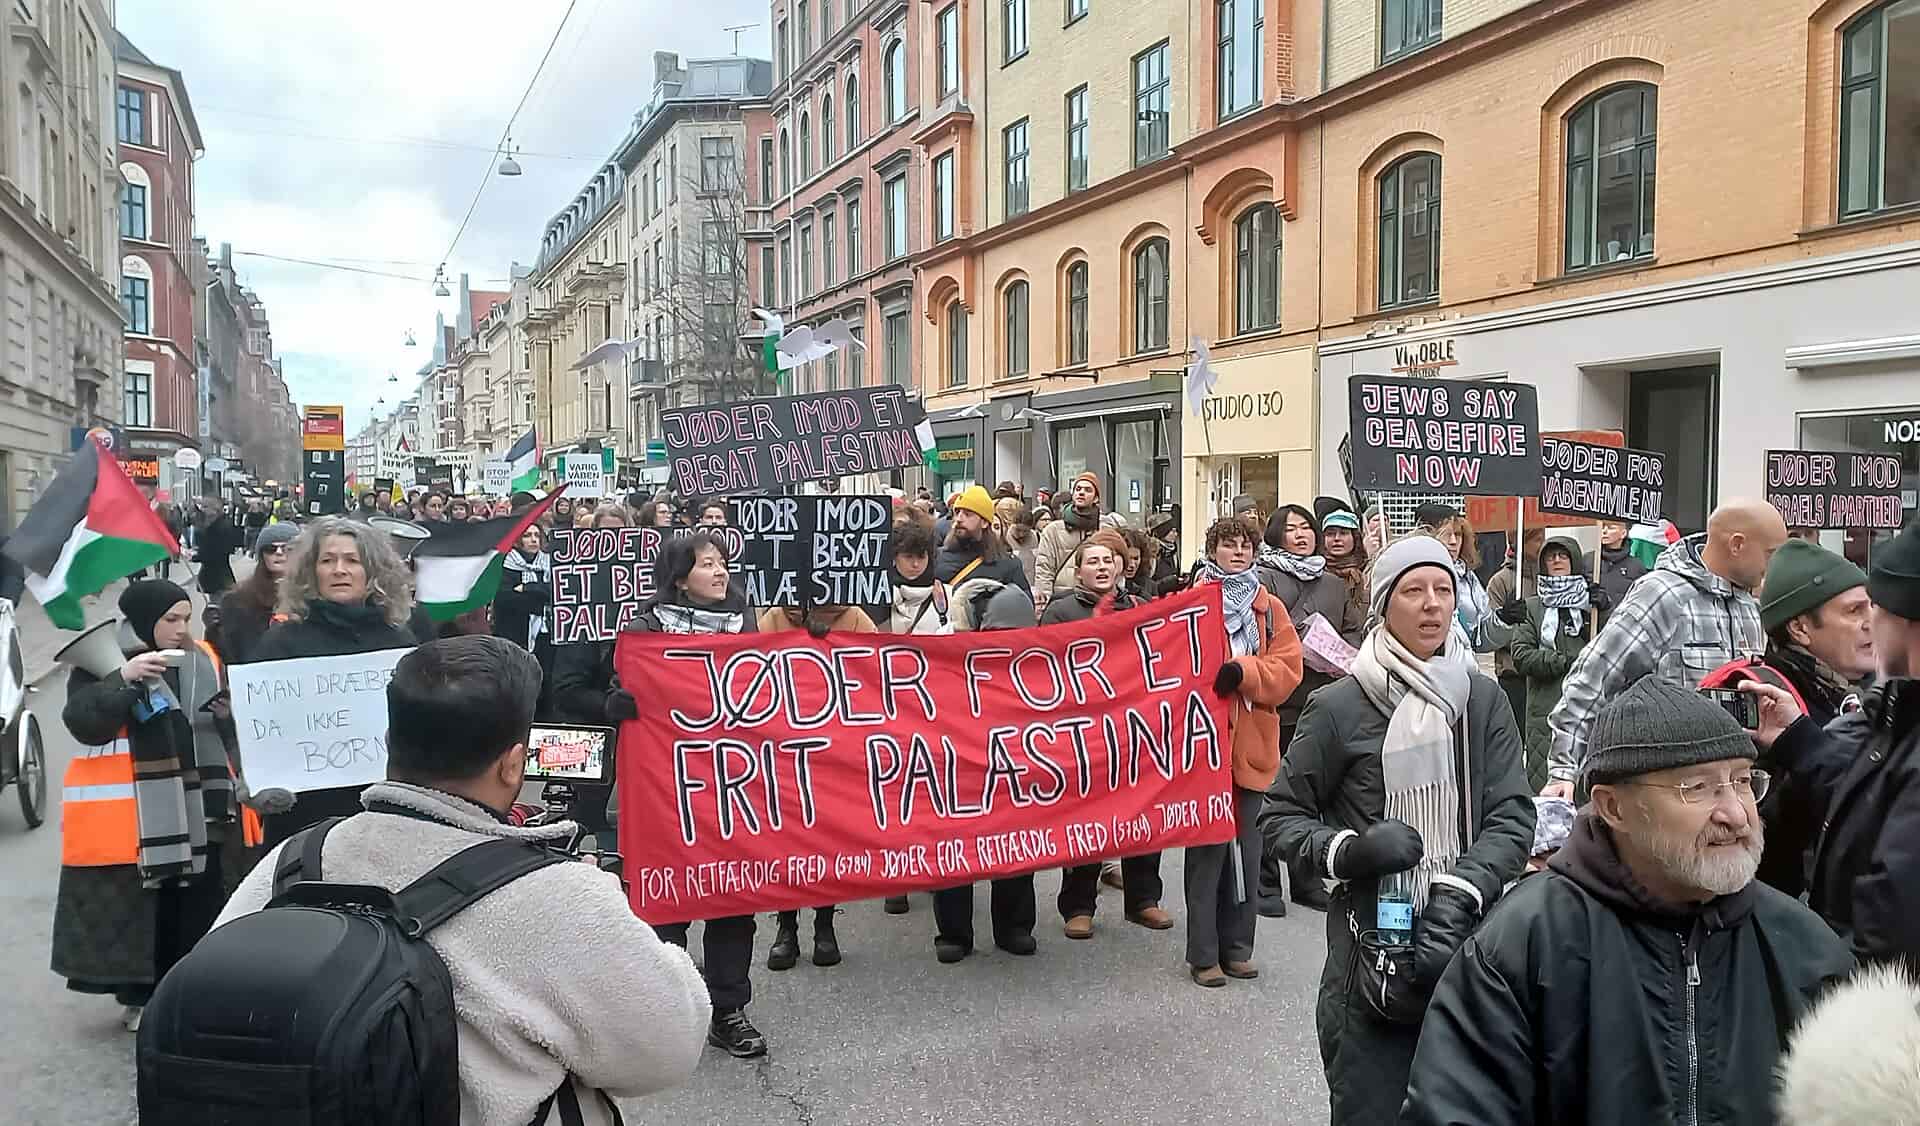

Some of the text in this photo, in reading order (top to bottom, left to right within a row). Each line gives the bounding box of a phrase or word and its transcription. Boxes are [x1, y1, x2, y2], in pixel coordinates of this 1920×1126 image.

[1395, 339, 1455, 370] VINOBLE
[663, 391, 904, 448] JØDER IMOD ET
[1205, 390, 1283, 421] STUDIO 130
[1362, 384, 1517, 419] JEWS SAY
[1366, 418, 1526, 457] CEASEFIRE
[676, 428, 923, 497] BESAT PALÆSTINA
[1396, 453, 1481, 488] NOW
[1542, 439, 1663, 486] JØDER FOR
[1768, 454, 1900, 489] JØDER IMOD
[729, 497, 887, 533] JØDER IMOD
[1829, 495, 1902, 529] APARTHEID
[553, 528, 662, 562] JØDER
[812, 532, 889, 569] BESAT
[552, 564, 598, 604] ET
[663, 646, 936, 732] JØDER
[965, 638, 1117, 718] FOR
[1134, 606, 1209, 692] ET
[246, 676, 302, 704] MAN
[252, 708, 352, 740] DA IKKE
[673, 691, 1221, 846] FRIT PALÆSTINA
[640, 792, 1234, 908] FOR RETFÆRDIG FRED (5784) JØDER FOR RETFÆRDIG FRED (5784) JØDER FOR
